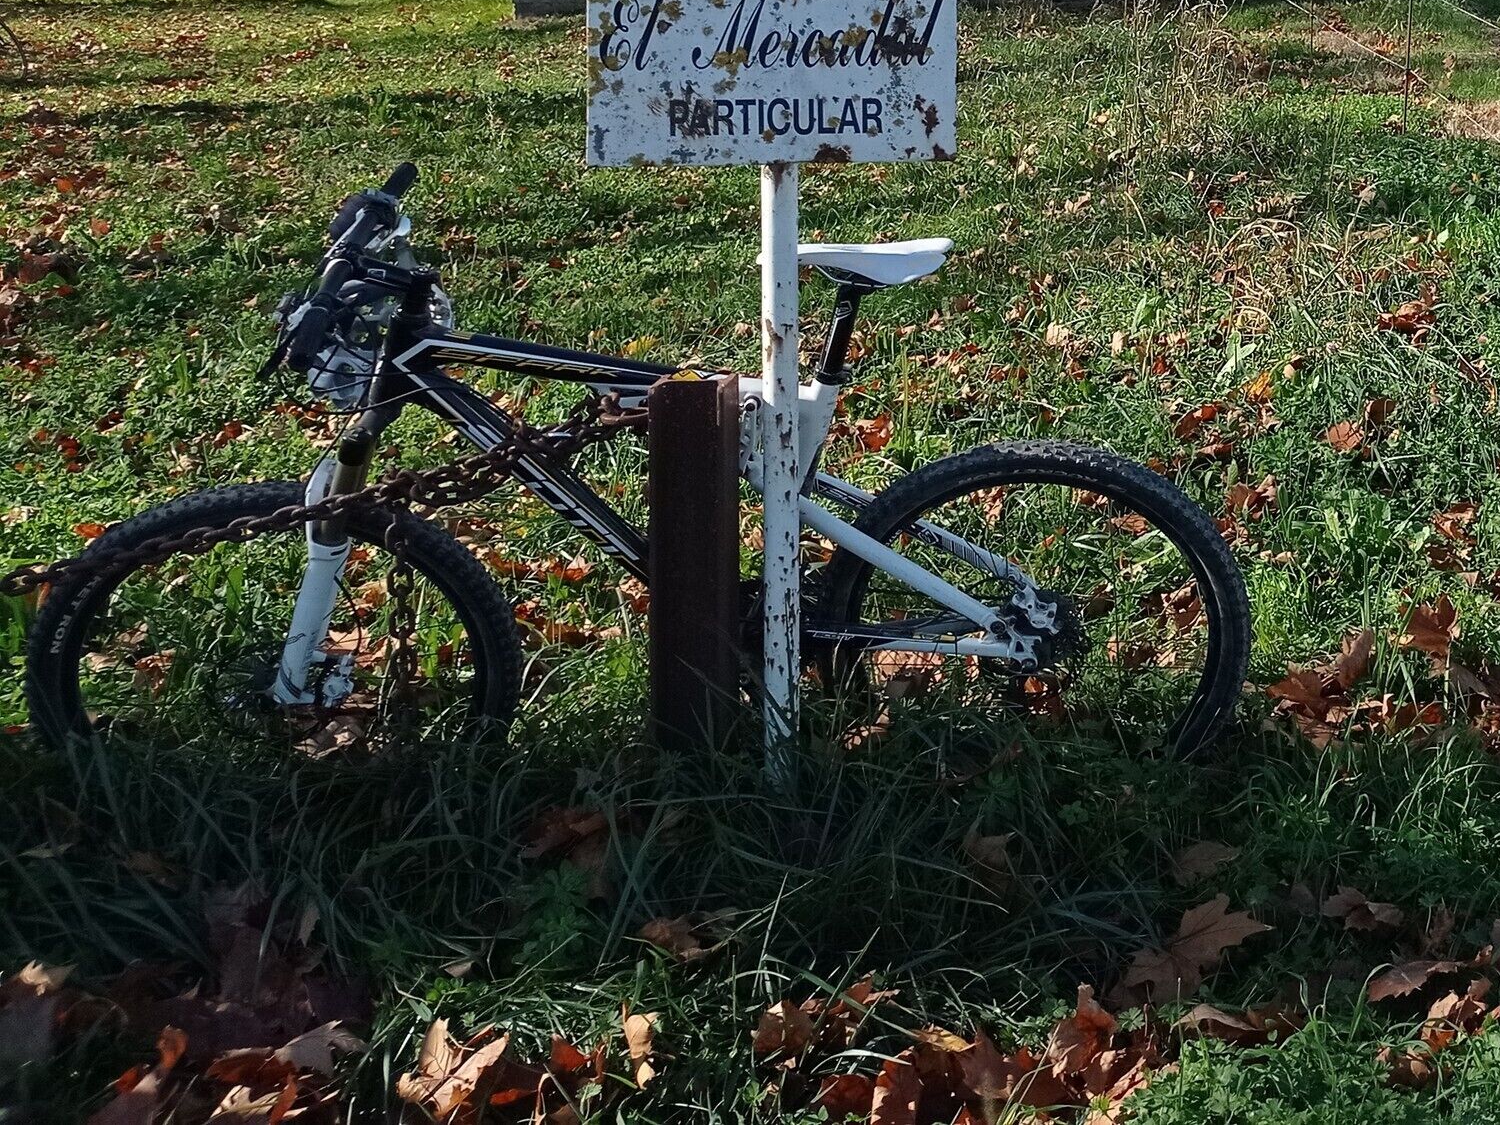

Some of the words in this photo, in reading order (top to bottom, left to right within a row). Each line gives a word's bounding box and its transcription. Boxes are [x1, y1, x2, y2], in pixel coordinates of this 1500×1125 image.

[669, 98, 884, 137] PARTICULAR
[430, 347, 621, 377] SPARK
[50, 614, 73, 654] RON
